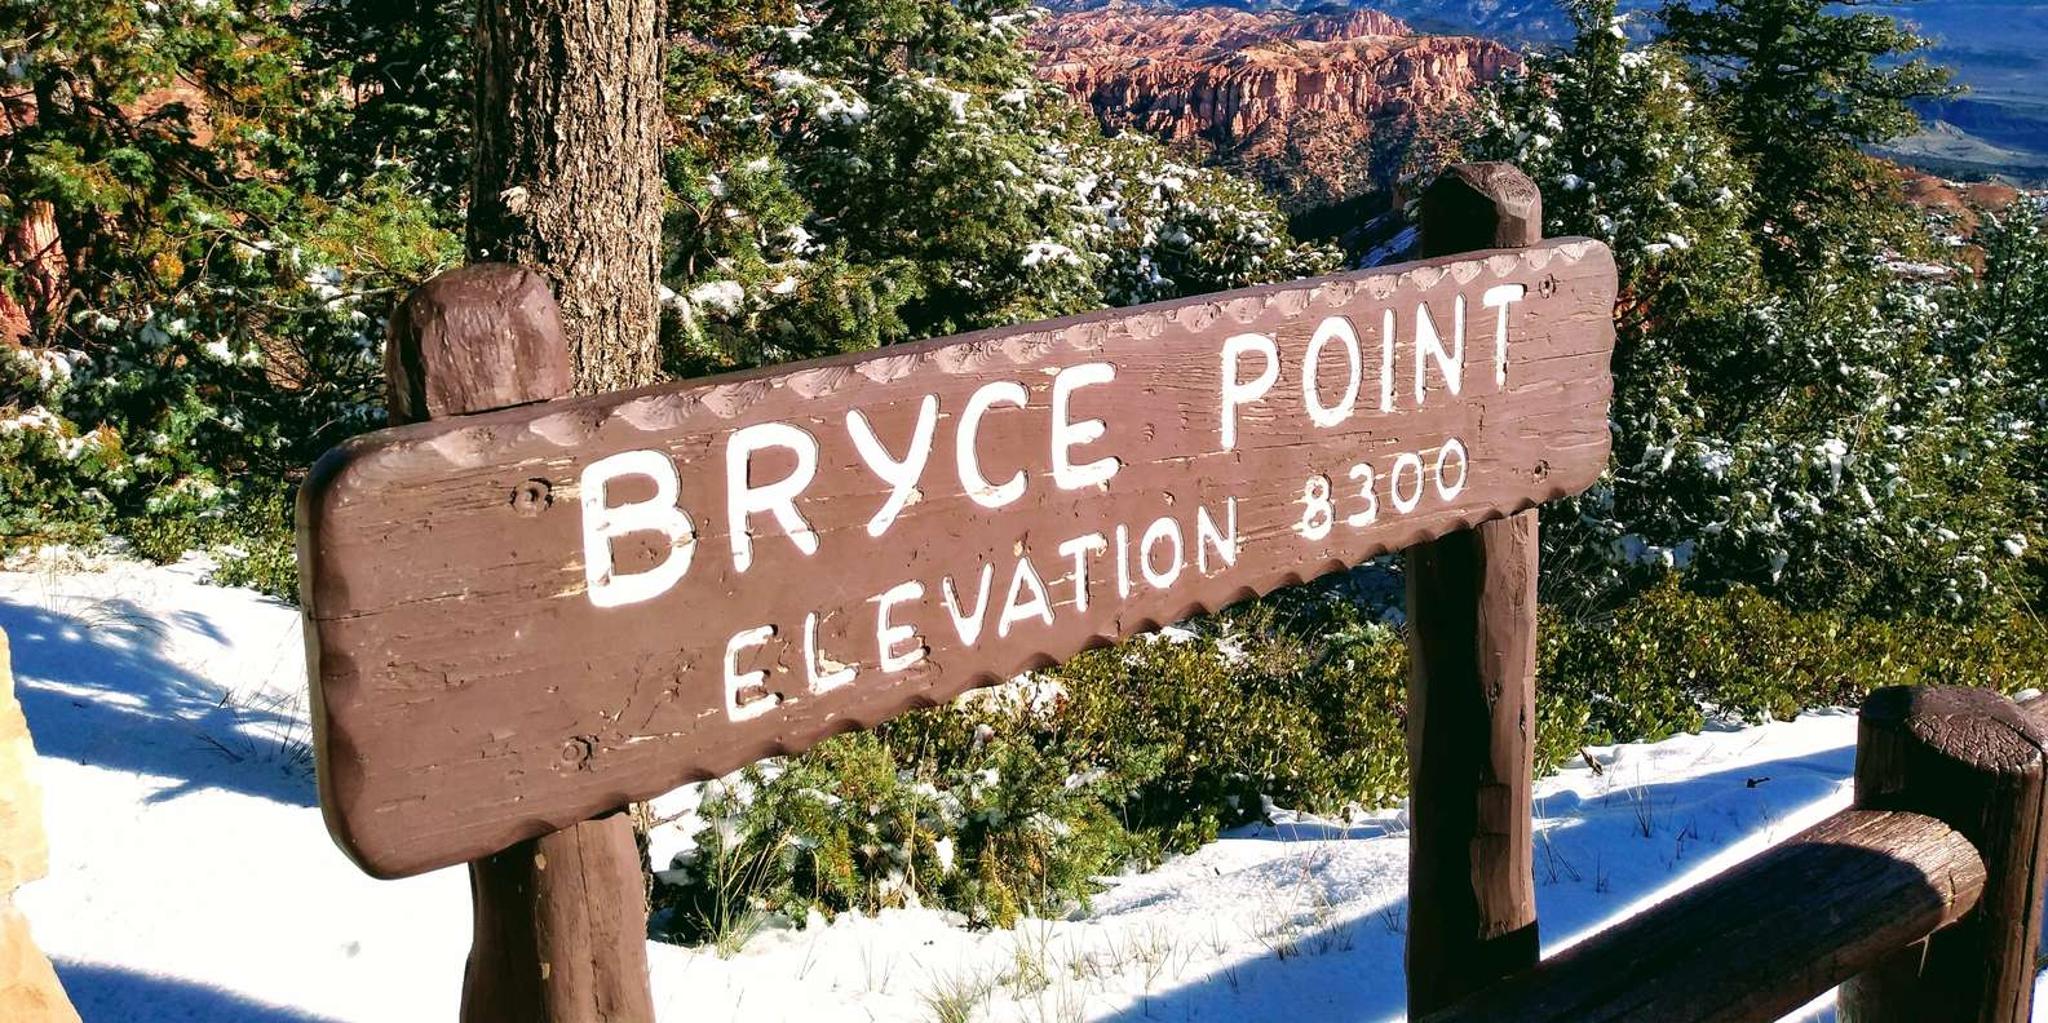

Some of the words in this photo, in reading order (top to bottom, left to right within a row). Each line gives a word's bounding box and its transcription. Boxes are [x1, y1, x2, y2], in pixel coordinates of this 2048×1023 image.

[580, 362, 1121, 609] BRYCE
[1219, 283, 1526, 451] POINT
[723, 496, 1239, 723] ELEVATION
[1297, 438, 1469, 542] 8300
